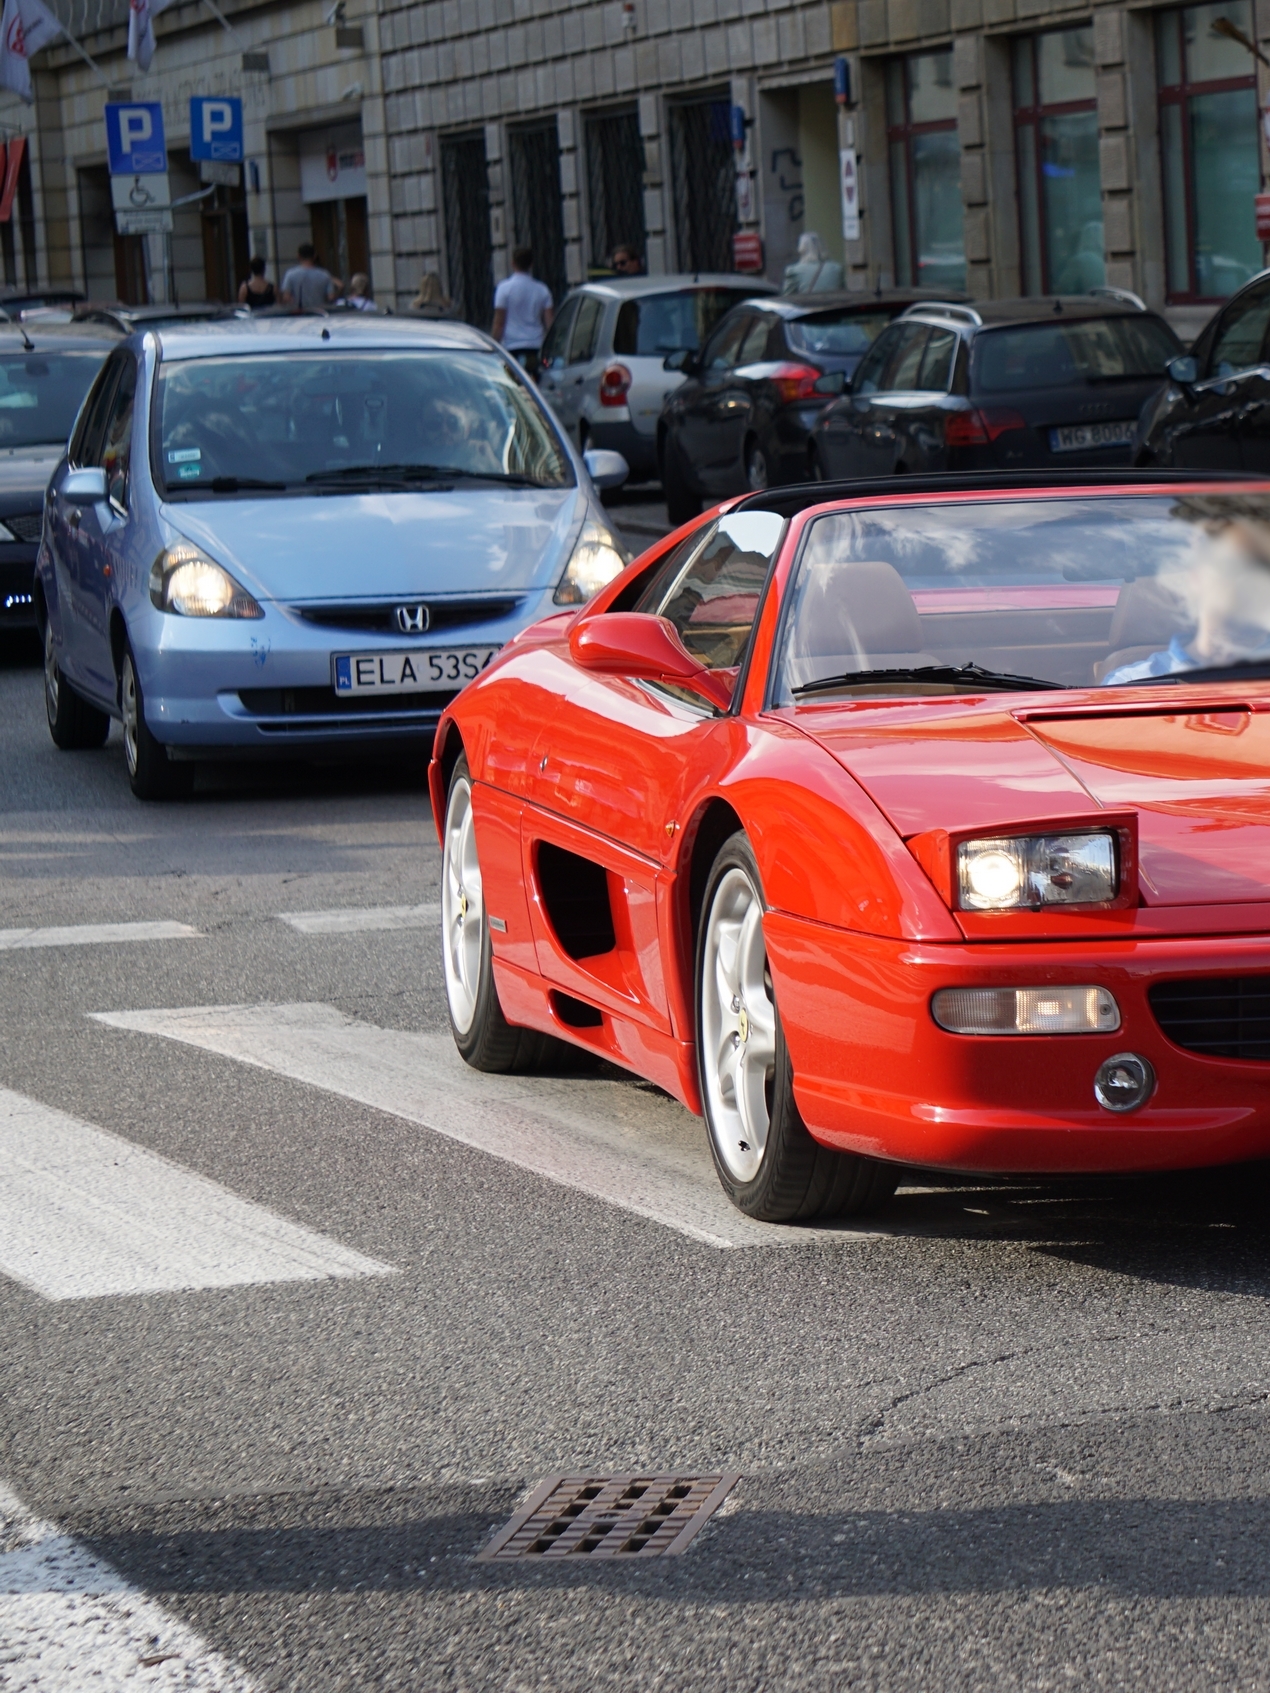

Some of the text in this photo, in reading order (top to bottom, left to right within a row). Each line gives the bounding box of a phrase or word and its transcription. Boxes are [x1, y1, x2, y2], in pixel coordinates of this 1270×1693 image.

[118, 108, 153, 154] P
[203, 101, 233, 143] P
[356, 656, 417, 686] ELA
